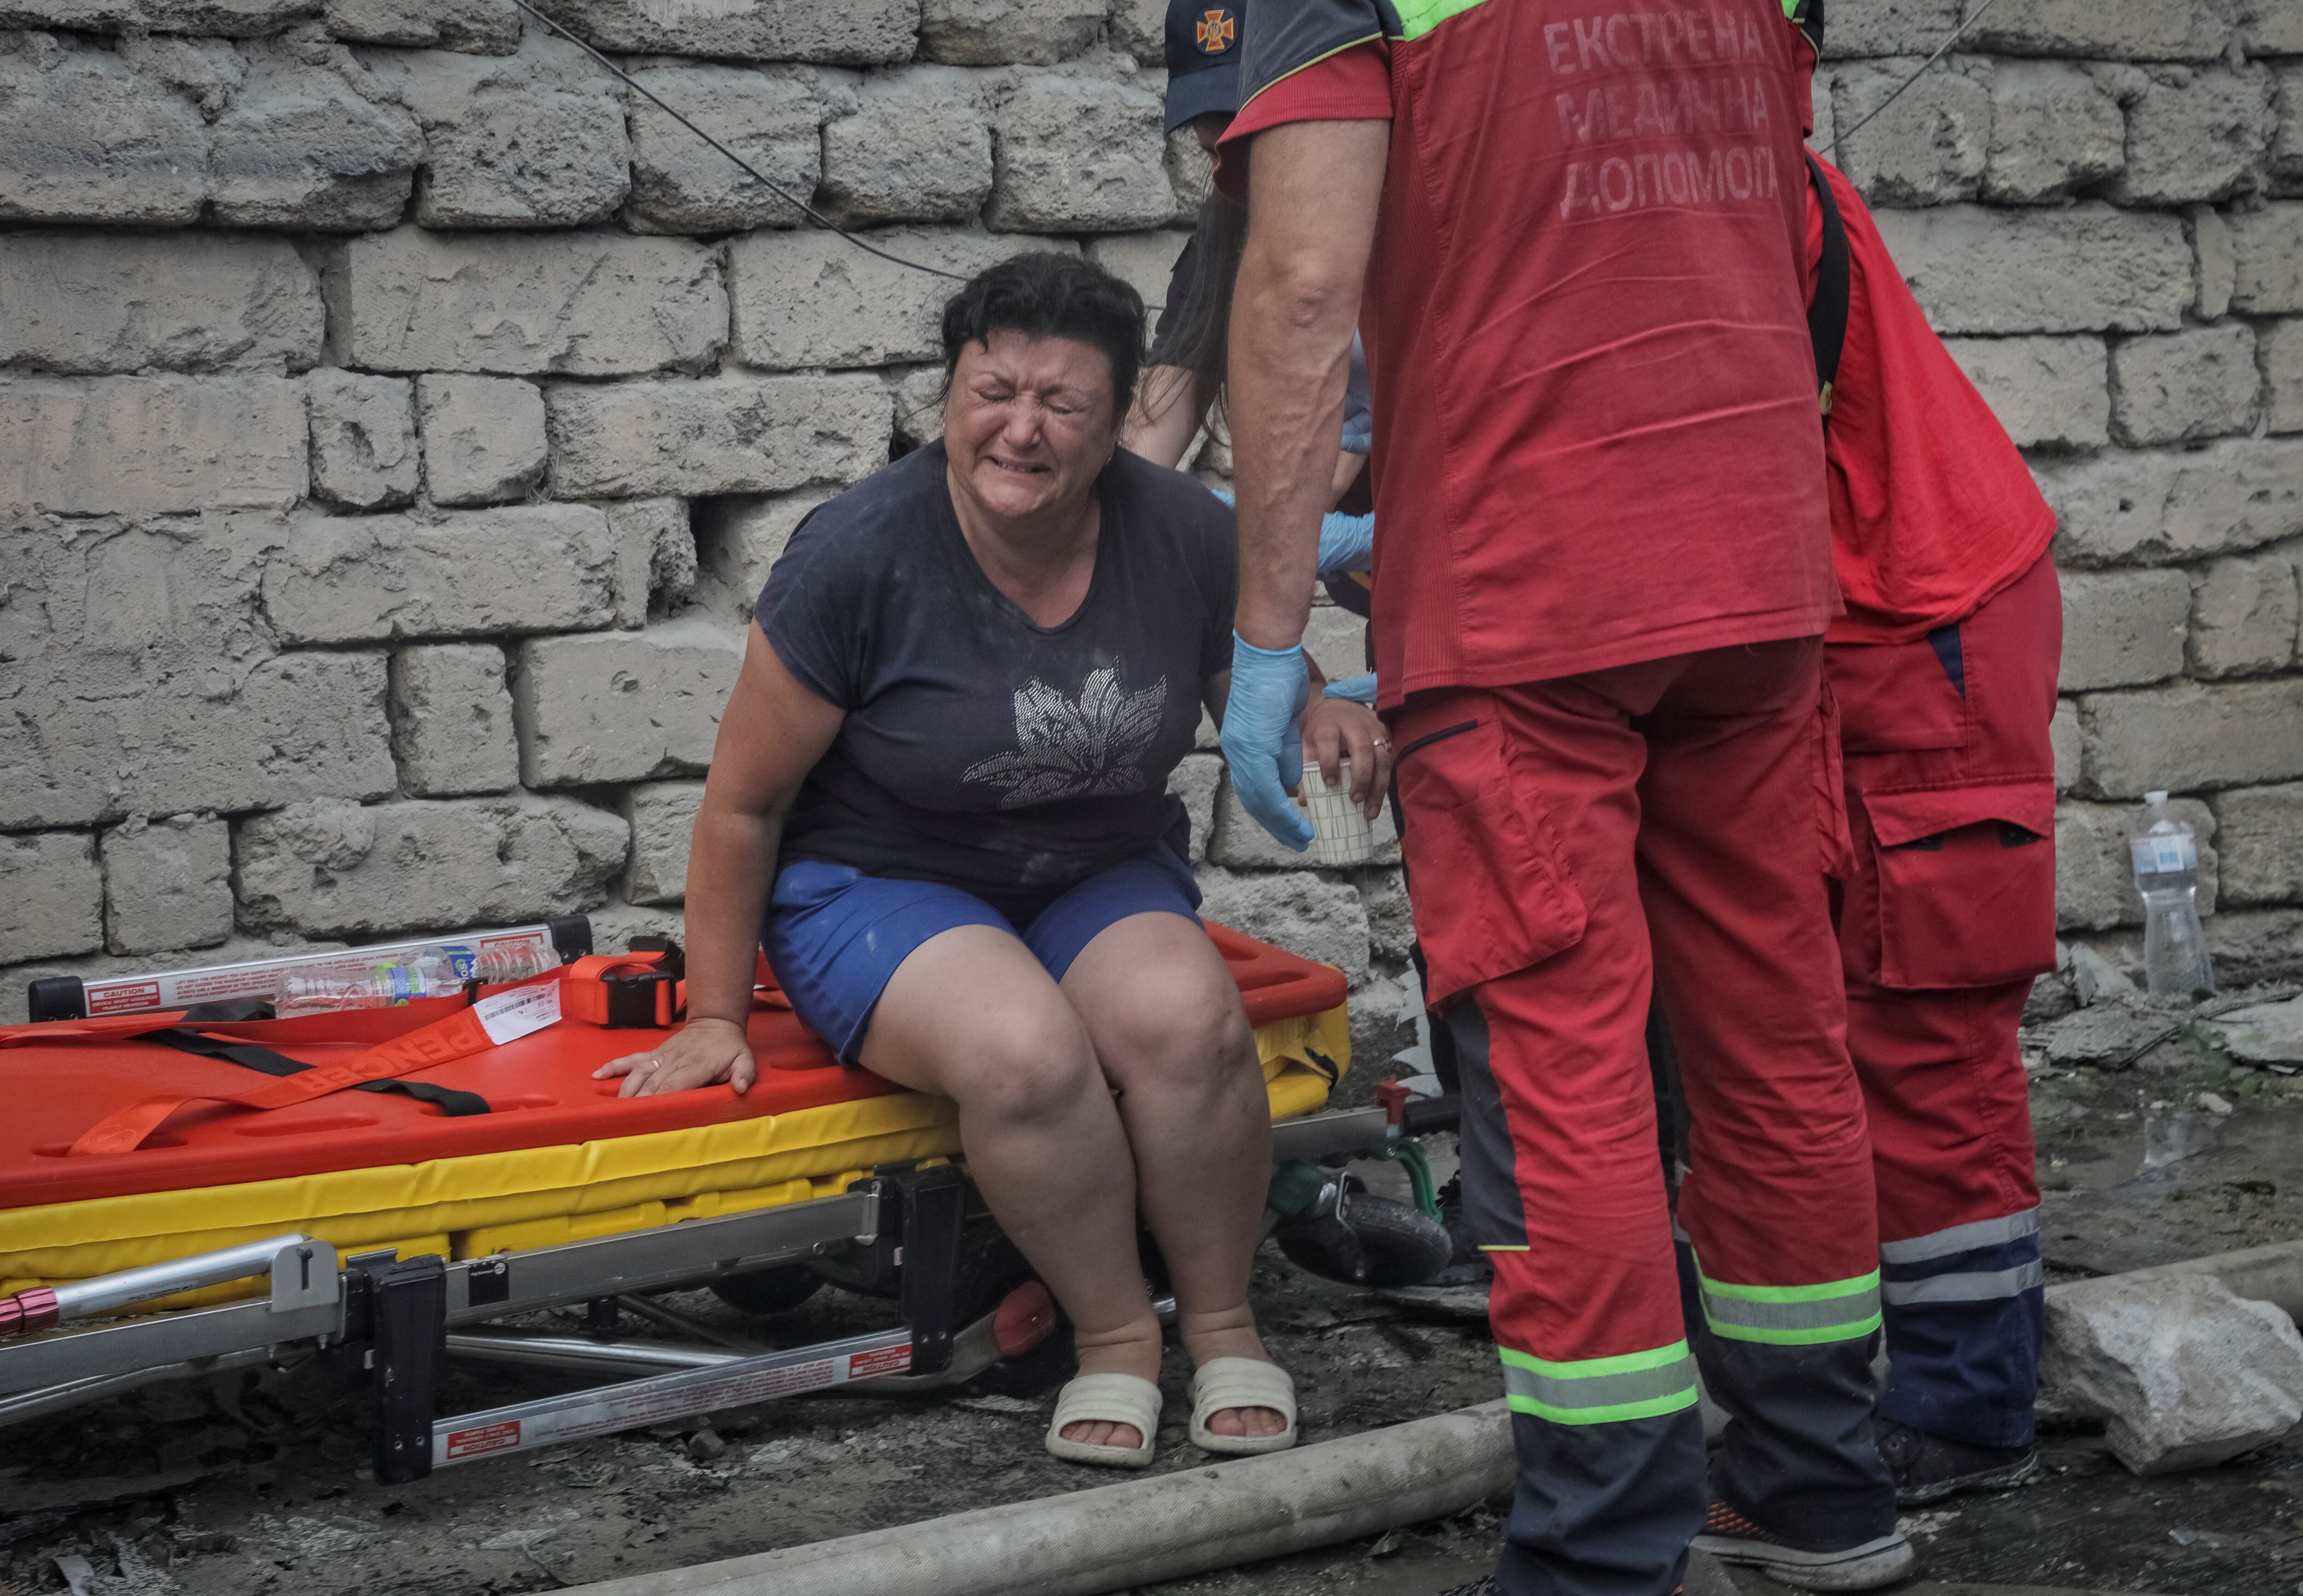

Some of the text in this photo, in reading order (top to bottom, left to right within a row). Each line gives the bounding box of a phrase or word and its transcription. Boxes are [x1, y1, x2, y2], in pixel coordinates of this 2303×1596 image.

[1543, 8, 1765, 75] ЕКСТРЕНА
[1556, 77, 1770, 143] МЕДИЧНА
[104, 987, 145, 998] CAUTION
[863, 1361, 900, 1372] CAUTION
[462, 1439, 505, 1451] CAUTION
